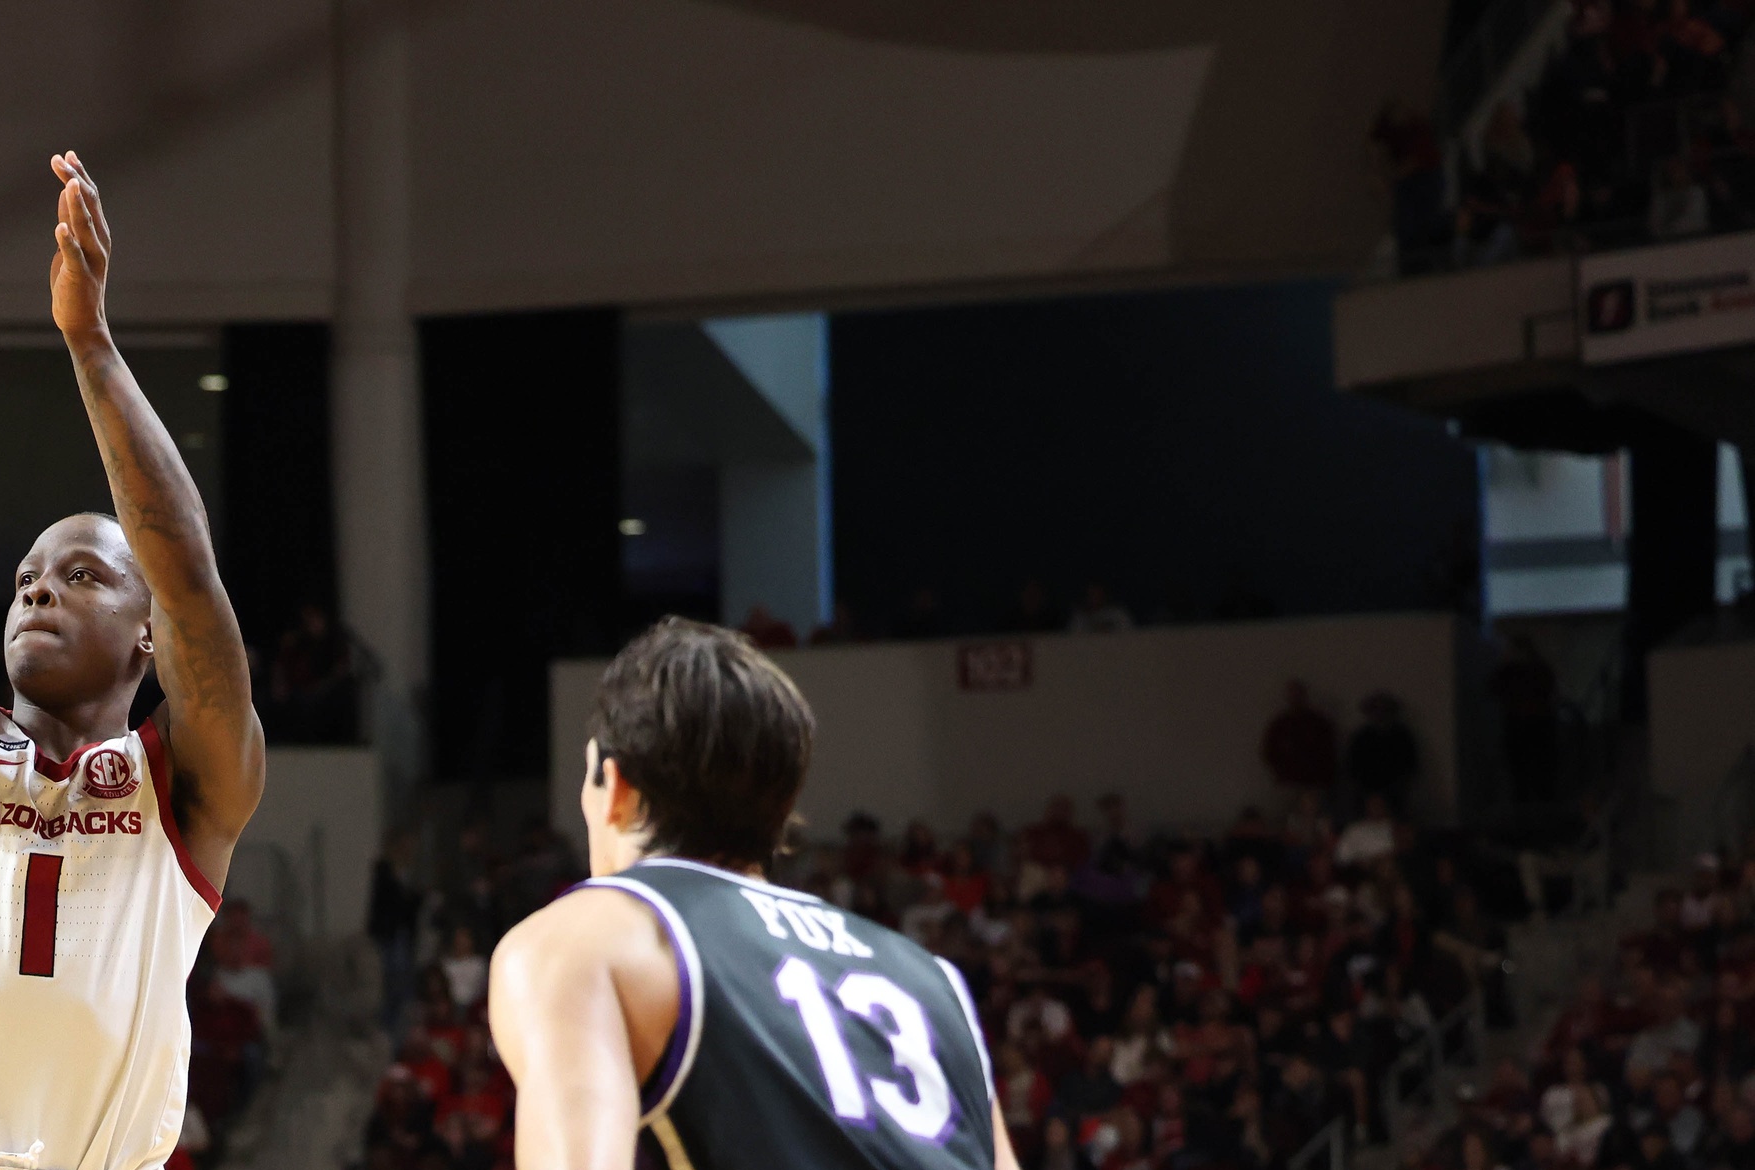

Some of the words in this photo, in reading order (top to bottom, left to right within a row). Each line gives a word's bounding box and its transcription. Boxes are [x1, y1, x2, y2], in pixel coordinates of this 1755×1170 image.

[89, 752, 127, 786] SEC
[19, 852, 64, 978] 1
[739, 887, 874, 958] FOX
[774, 954, 956, 1144] 13
